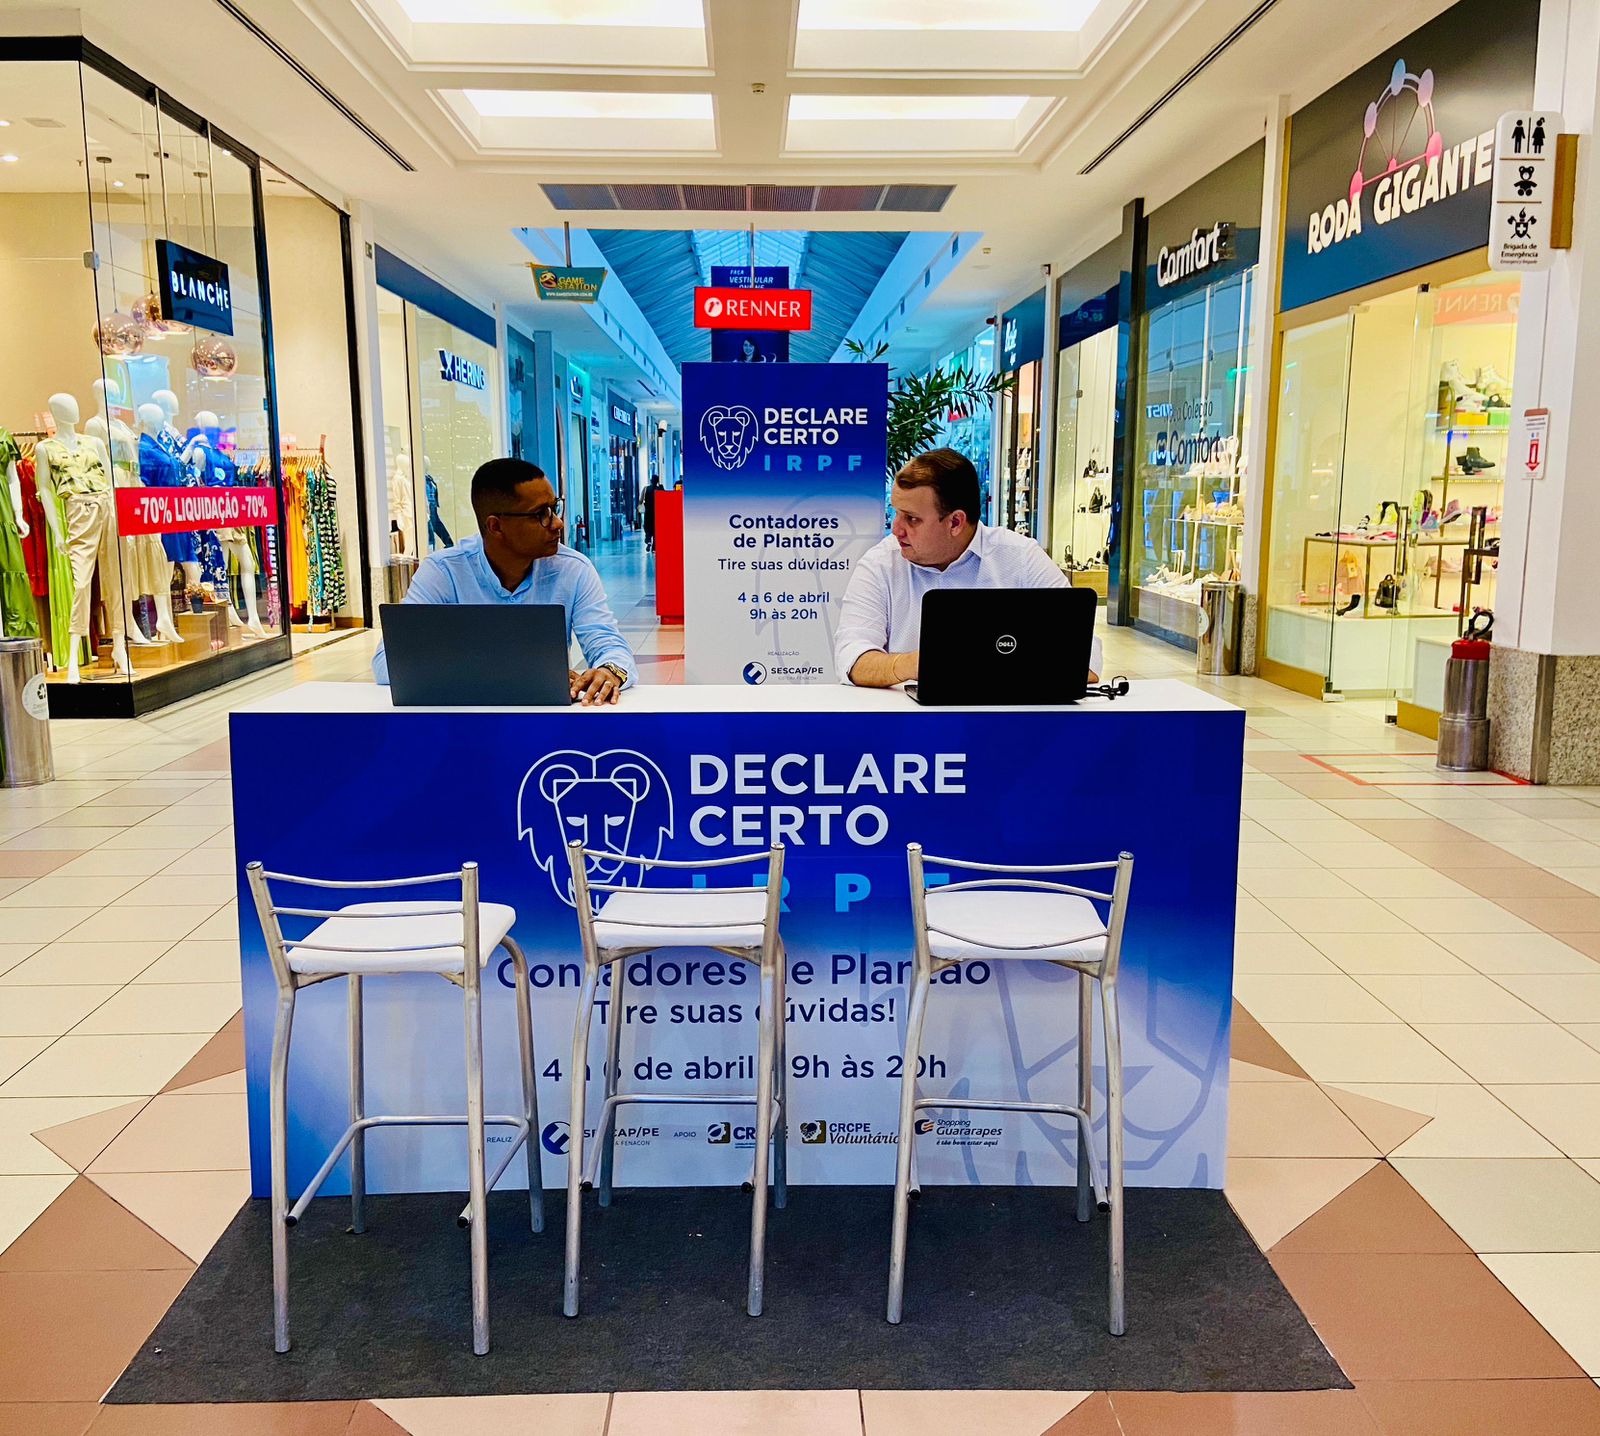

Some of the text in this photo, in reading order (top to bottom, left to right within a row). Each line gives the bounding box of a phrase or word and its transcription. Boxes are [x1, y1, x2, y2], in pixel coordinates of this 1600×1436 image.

[1307, 129, 1495, 254] RODA GIGANTE
[1157, 221, 1220, 287] Comfort
[729, 276, 774, 284] VESTIULAR
[171, 270, 229, 311] BLANCHE
[726, 299, 801, 317] RENNER
[764, 408, 868, 425] DECLARE
[764, 428, 839, 445] CERTO
[1170, 427, 1221, 466] Comfort
[174, 492, 239, 525] LIQUIDAÇÃO
[729, 514, 839, 529] Contadores
[733, 533, 834, 548] de Plantão
[718, 558, 850, 570] Tire suas dúvidas!
[738, 592, 830, 603] 4 a 6 de abril
[750, 608, 818, 620] 9h às 20h
[771, 667, 824, 675] SESCAP/PE
[690, 753, 967, 795] DECLARE
[689, 804, 889, 847] CERTO
[497, 954, 747, 988] Condores
[832, 953, 990, 985] Planão
[593, 997, 895, 1024] Tre suas úvidas!
[543, 1058, 562, 1082] 4
[633, 1056, 673, 1080] de
[684, 1055, 753, 1080] abril
[791, 1055, 830, 1079] 9h
[841, 1054, 874, 1079] às
[829, 1122, 871, 1133] CRCPE
[936, 1119, 972, 1128] Shopping
[936, 1127, 1003, 1138] Guararapes
